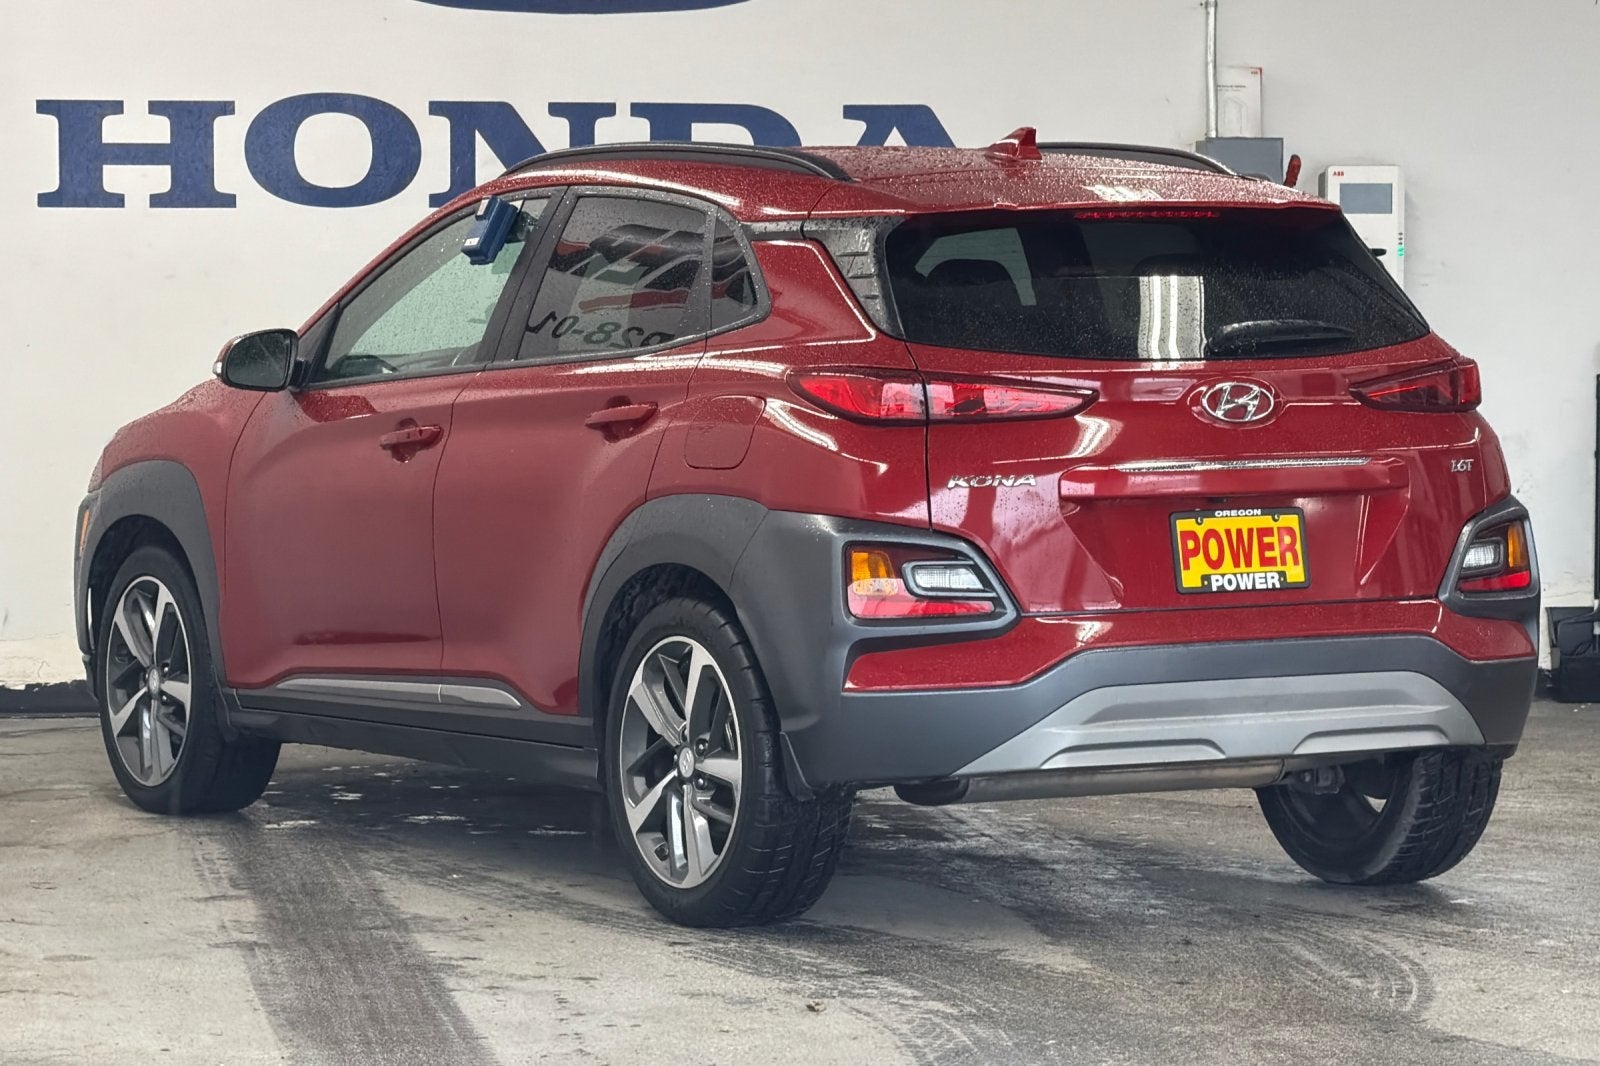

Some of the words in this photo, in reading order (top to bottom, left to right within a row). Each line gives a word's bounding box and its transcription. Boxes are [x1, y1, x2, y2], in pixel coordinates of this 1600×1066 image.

[947, 474, 1037, 489] KONA
[1214, 509, 1261, 517] OREGON
[1180, 526, 1300, 571] POWER
[1210, 572, 1281, 592] POWER
